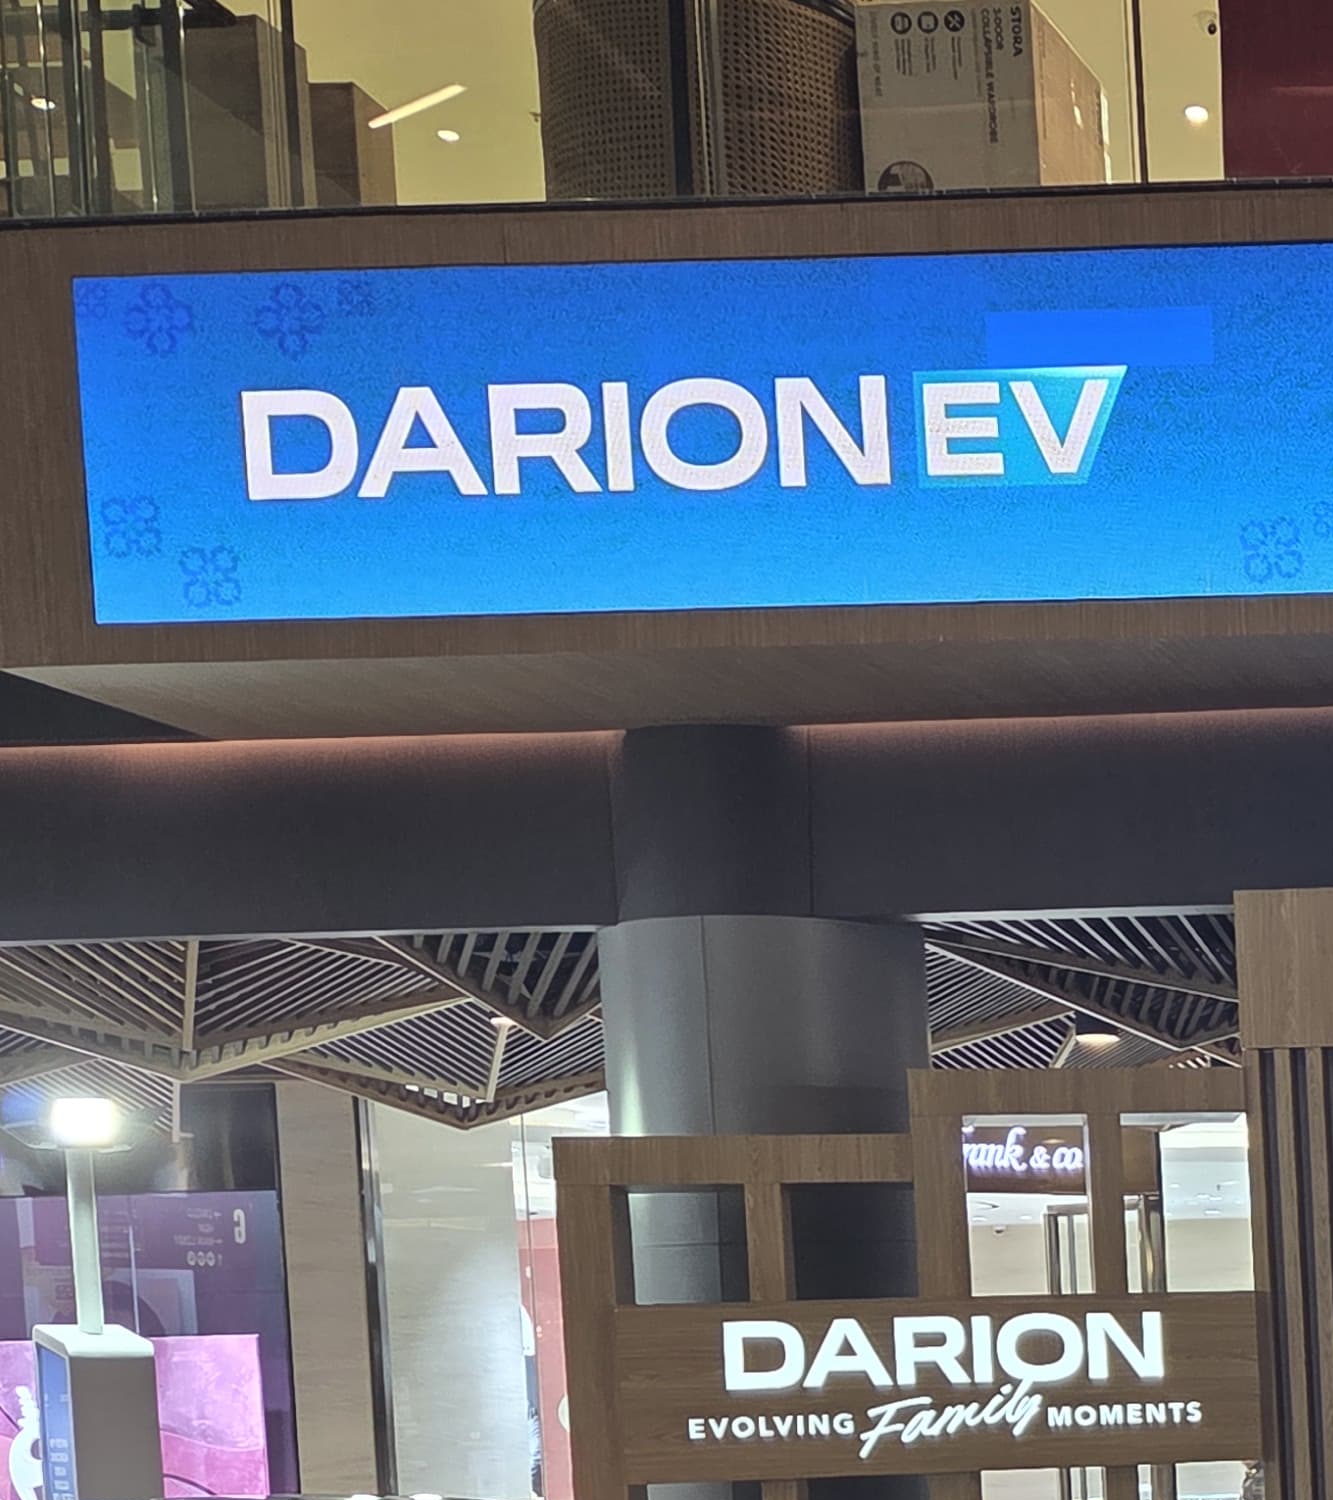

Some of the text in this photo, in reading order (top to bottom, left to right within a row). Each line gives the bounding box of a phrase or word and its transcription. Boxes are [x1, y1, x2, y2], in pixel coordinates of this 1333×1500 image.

[241, 374, 1109, 501] DARION EV
[961, 1126, 1027, 1171] rank
[1029, 1146, 1051, 1170] &
[722, 1311, 1164, 1391] DARION
[688, 1378, 1203, 1459] EVOLVING Family MOMENTS
